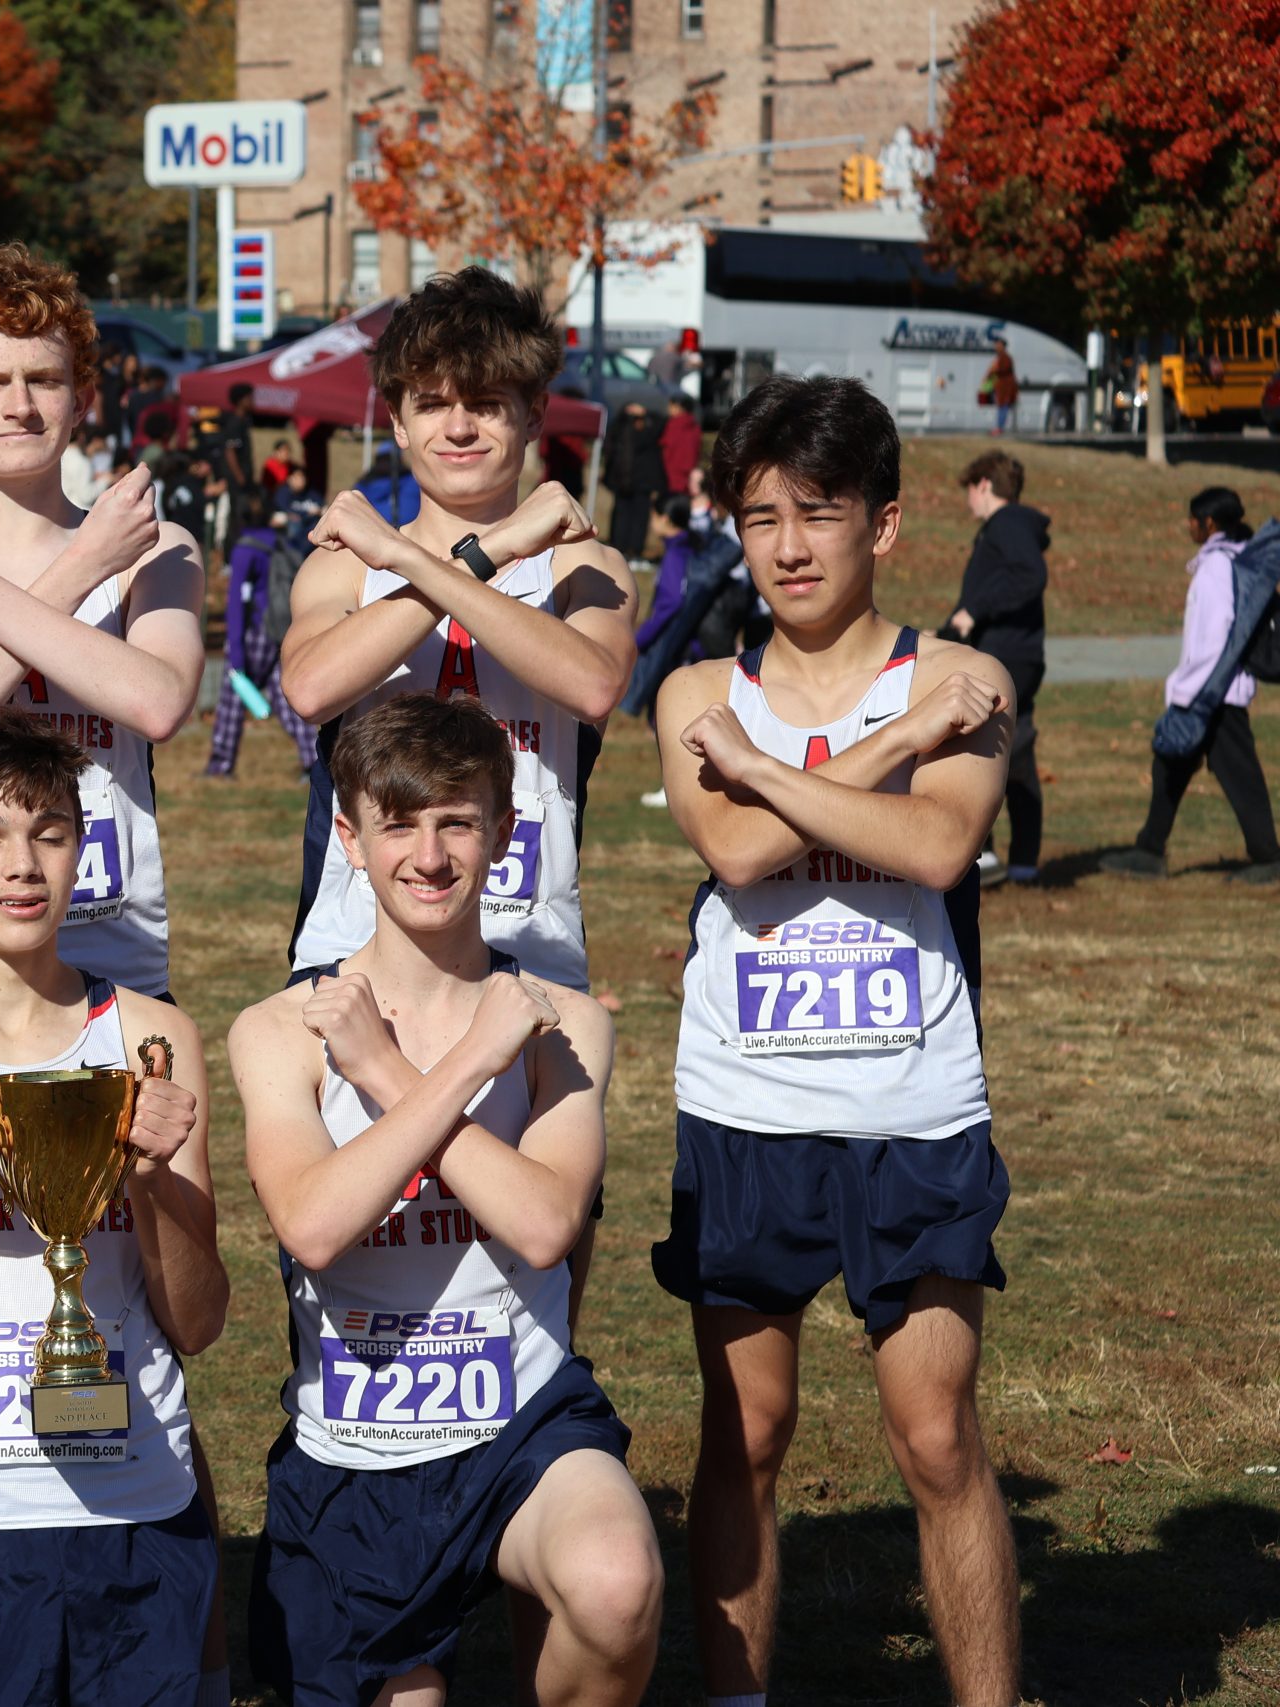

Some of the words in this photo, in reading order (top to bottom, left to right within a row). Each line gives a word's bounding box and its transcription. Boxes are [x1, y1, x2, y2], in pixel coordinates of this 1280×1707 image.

[161, 118, 284, 167] Mobil
[74, 841, 111, 899] 4
[486, 840, 525, 896] 5
[758, 951, 811, 966] CROSS
[815, 948, 894, 963] COUNTRY
[748, 968, 908, 1030] 7219
[745, 1032, 916, 1049] Live.FultonAccurateTiming.com
[345, 1340, 401, 1356] CROSS
[405, 1339, 486, 1356] COUNTRY
[334, 1360, 501, 1421] 7220
[54, 1414, 74, 1423] 2ND
[77, 1412, 108, 1421] PLACE
[329, 1423, 503, 1441] Live.FultonAccurateTiming.co
